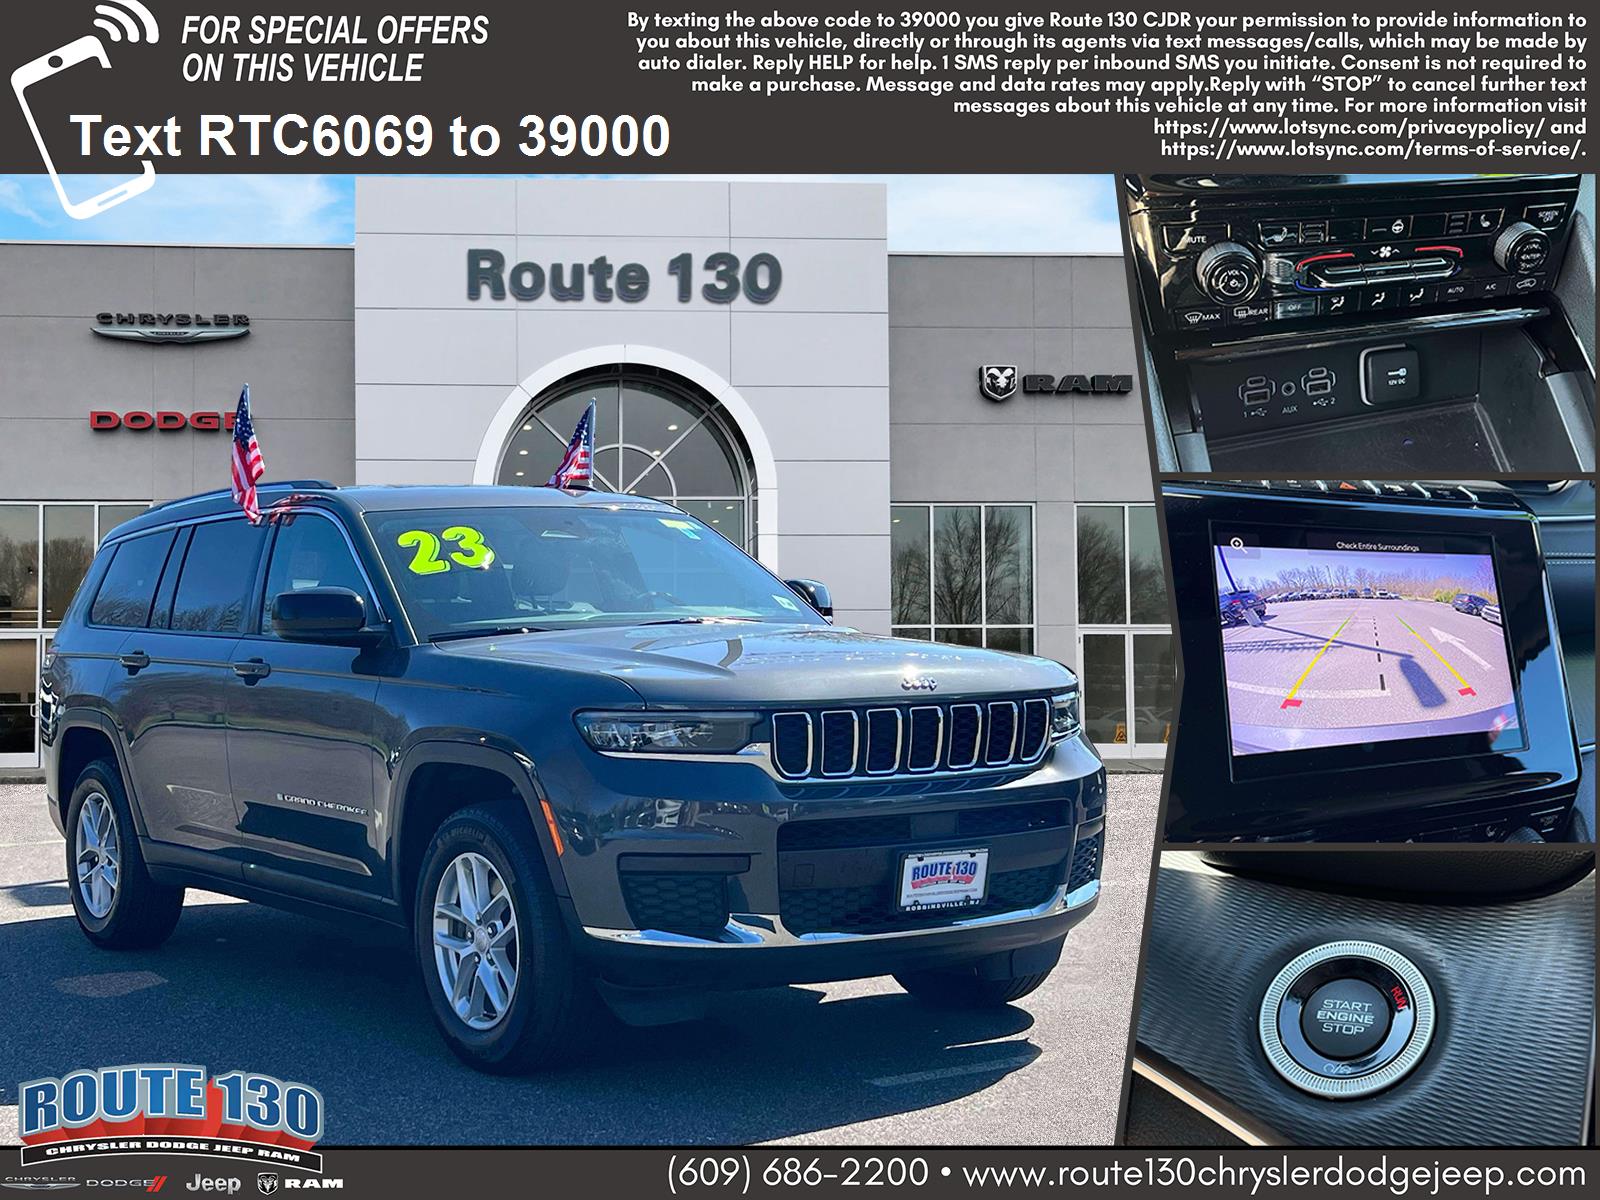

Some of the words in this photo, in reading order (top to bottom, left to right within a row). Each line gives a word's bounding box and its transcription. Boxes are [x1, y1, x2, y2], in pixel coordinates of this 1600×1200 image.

[467, 248, 650, 302] Route
[668, 252, 783, 304] 130
[1447, 286, 1465, 294] AUTO
[1247, 307, 1269, 316] REAR
[96, 312, 250, 326] CHRYSLER
[1022, 374, 1134, 394] RAM
[1282, 405, 1299, 415] AUX
[398, 526, 495, 575] 23
[1336, 541, 1357, 549] Check
[1358, 542, 1377, 551] Entire
[1378, 543, 1420, 552] Surroundings
[284, 794, 316, 807] GRAND
[317, 800, 369, 816] CHEROKEE
[912, 861, 953, 880] ROUTE
[956, 861, 978, 876] 130
[1391, 985, 1408, 1011] RUN
[1322, 999, 1373, 1012] START
[1316, 1010, 1375, 1025] ENGINE
[1322, 1023, 1365, 1035] STOP
